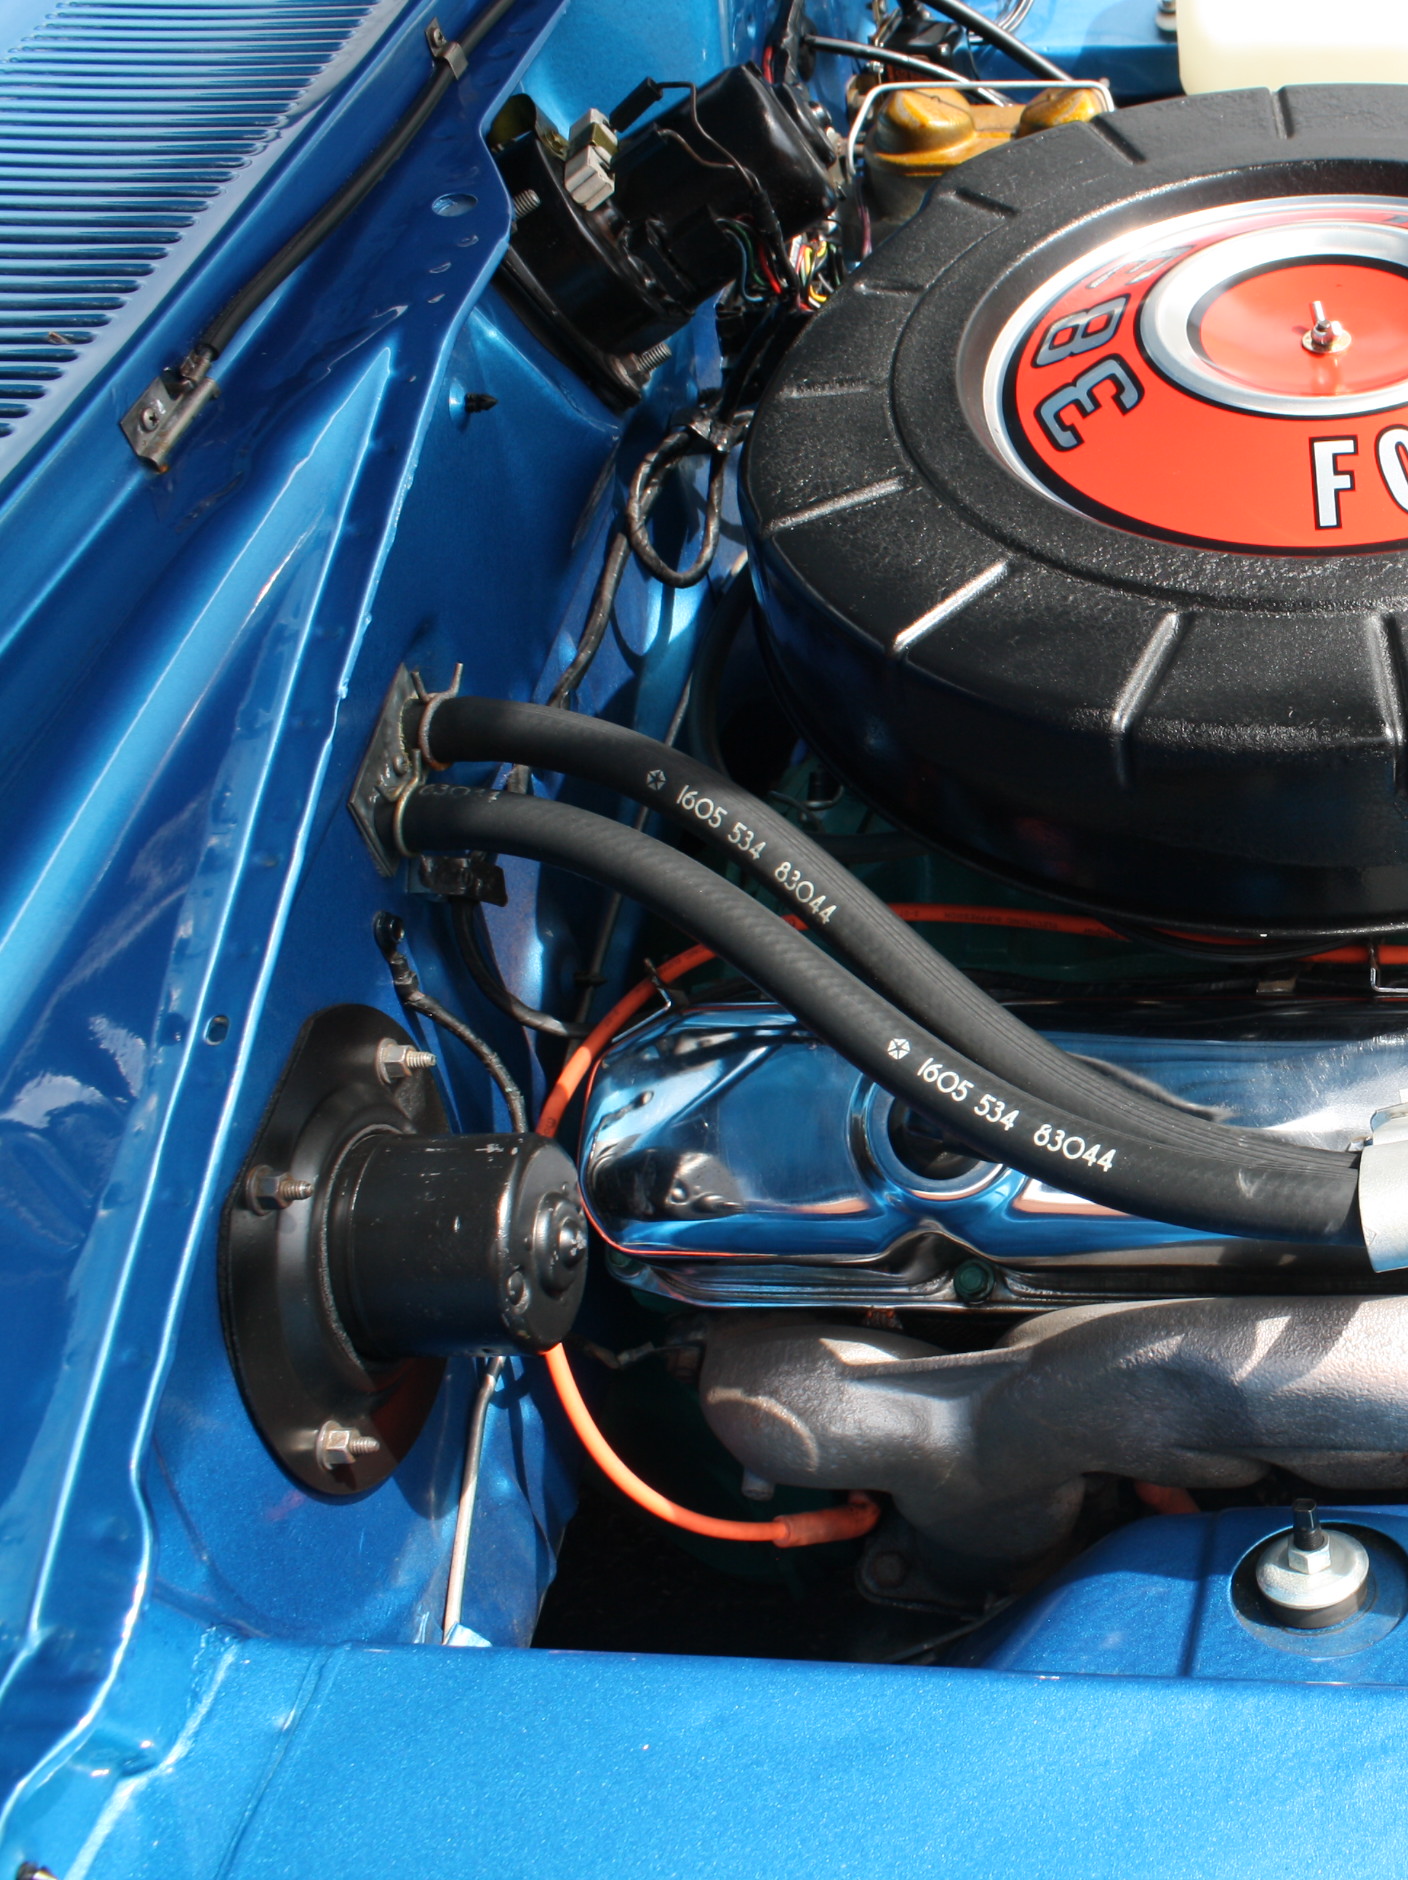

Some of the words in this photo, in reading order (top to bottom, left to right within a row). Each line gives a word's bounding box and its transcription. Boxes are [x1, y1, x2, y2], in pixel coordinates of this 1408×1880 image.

[1033, 244, 1197, 452] 383
[676, 785, 728, 829] 1605
[728, 821, 767, 861] 534
[774, 861, 838, 925] 83044
[916, 1057, 975, 1102] 1605
[974, 1093, 1020, 1131] 534
[1033, 1123, 1117, 1173] 83044
